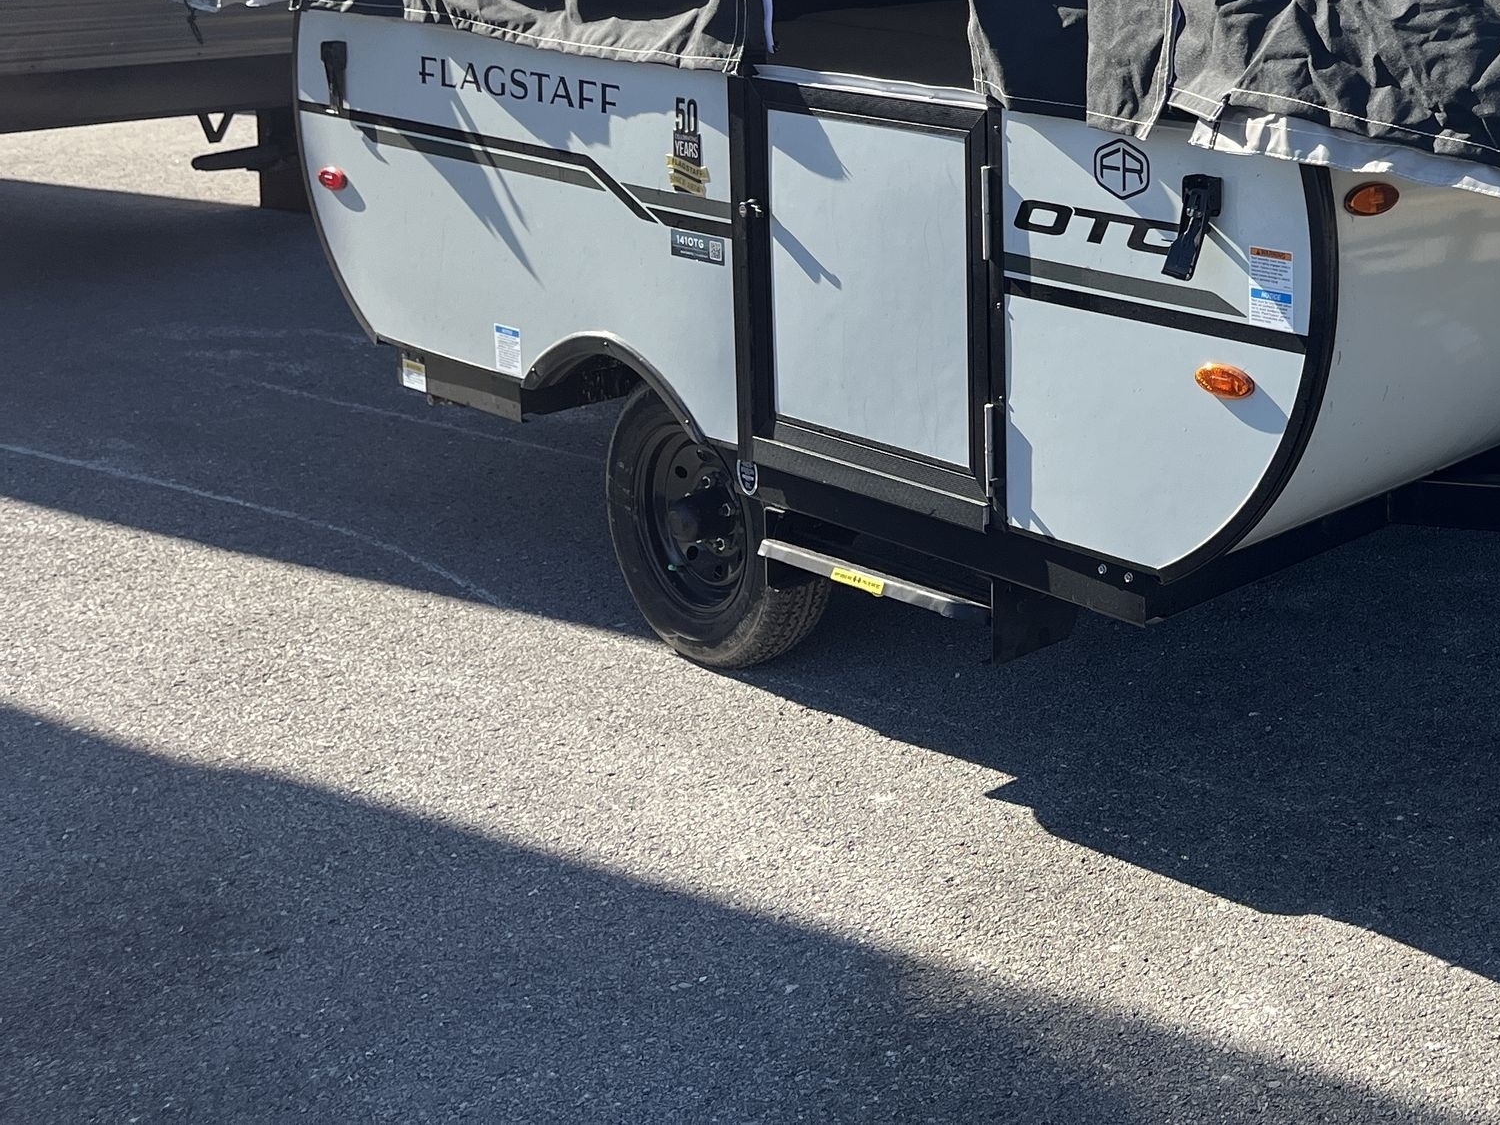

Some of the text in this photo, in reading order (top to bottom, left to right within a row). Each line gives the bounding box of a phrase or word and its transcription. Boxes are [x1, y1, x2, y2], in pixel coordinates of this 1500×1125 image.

[418, 56, 621, 114] FLAGSTAFF
[675, 97, 698, 132] 50
[674, 140, 699, 158] YEARS
[1261, 290, 1281, 301] NOTICE
